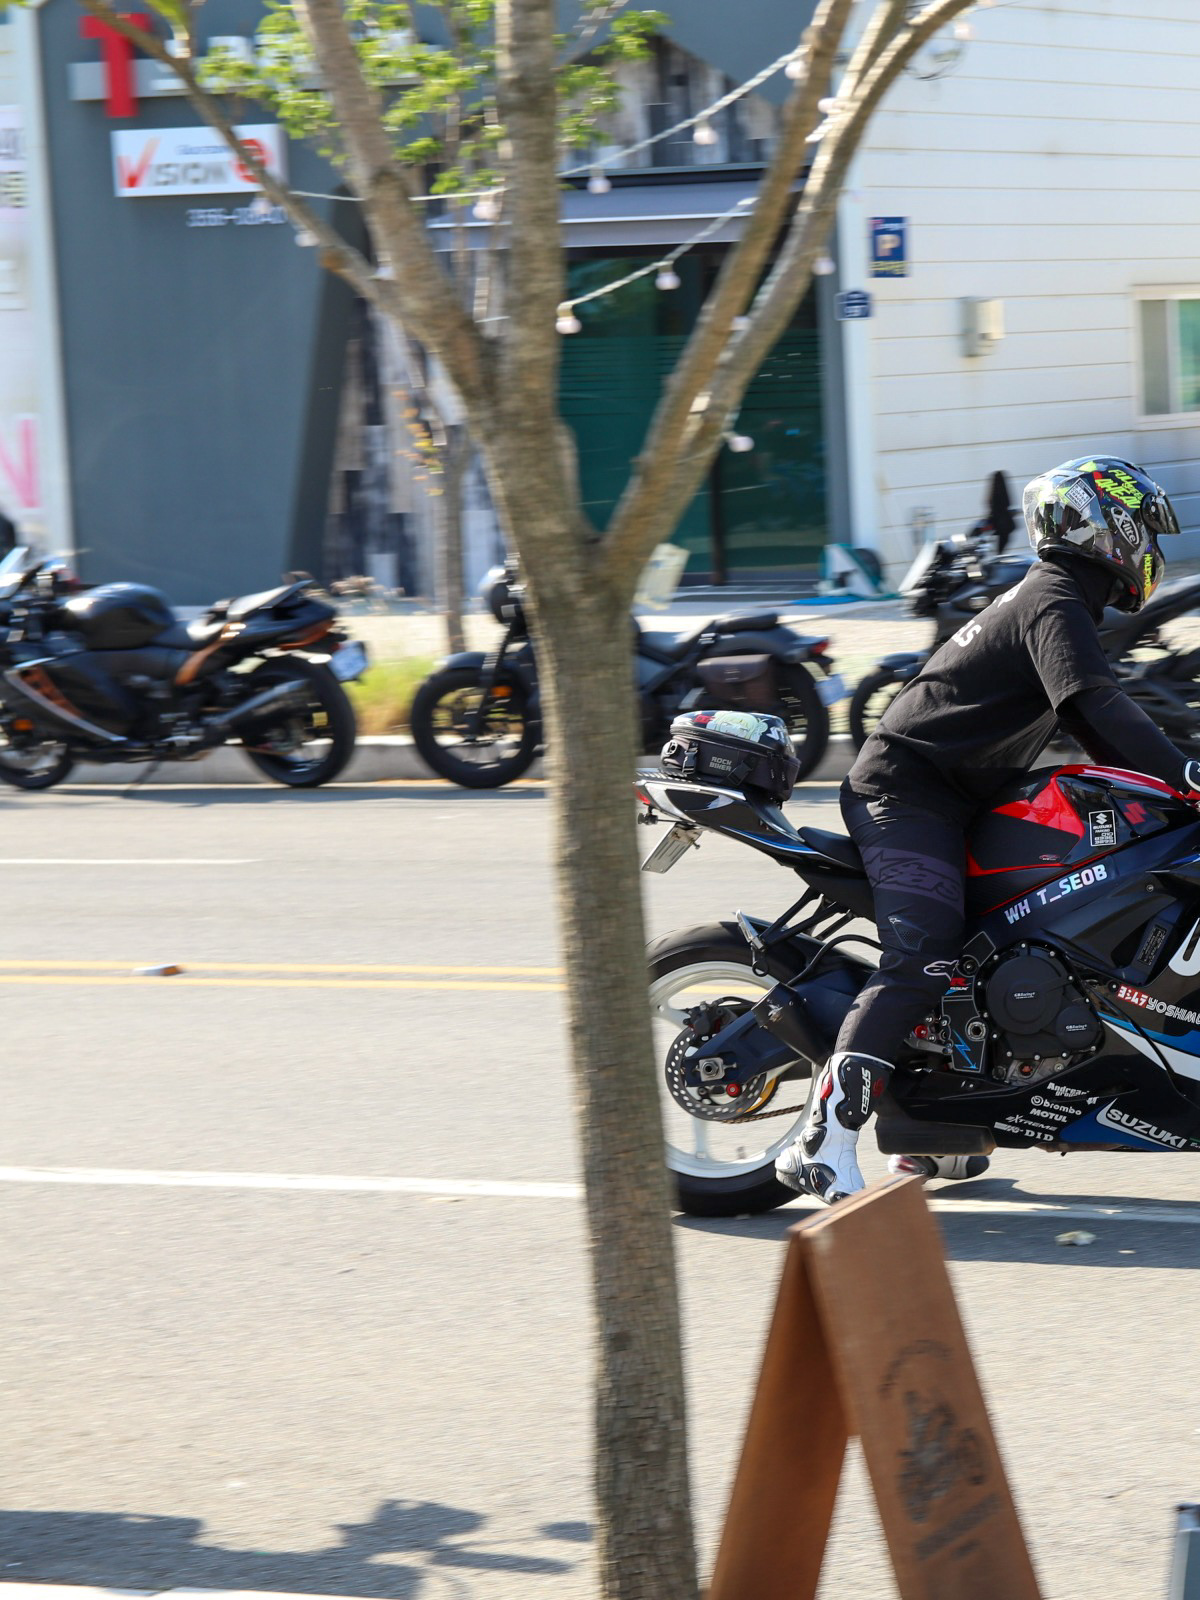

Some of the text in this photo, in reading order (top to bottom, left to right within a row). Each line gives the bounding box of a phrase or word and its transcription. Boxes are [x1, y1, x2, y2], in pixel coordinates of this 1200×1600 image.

[709, 762, 732, 772] BIKER
[711, 756, 733, 766] ROCK
[1117, 985, 1149, 1008] ヨシムラ
[861, 1066, 872, 1116] SPEED
[1030, 1108, 1068, 1123] MOTUL
[1106, 1108, 1188, 1149] SUZUKI
